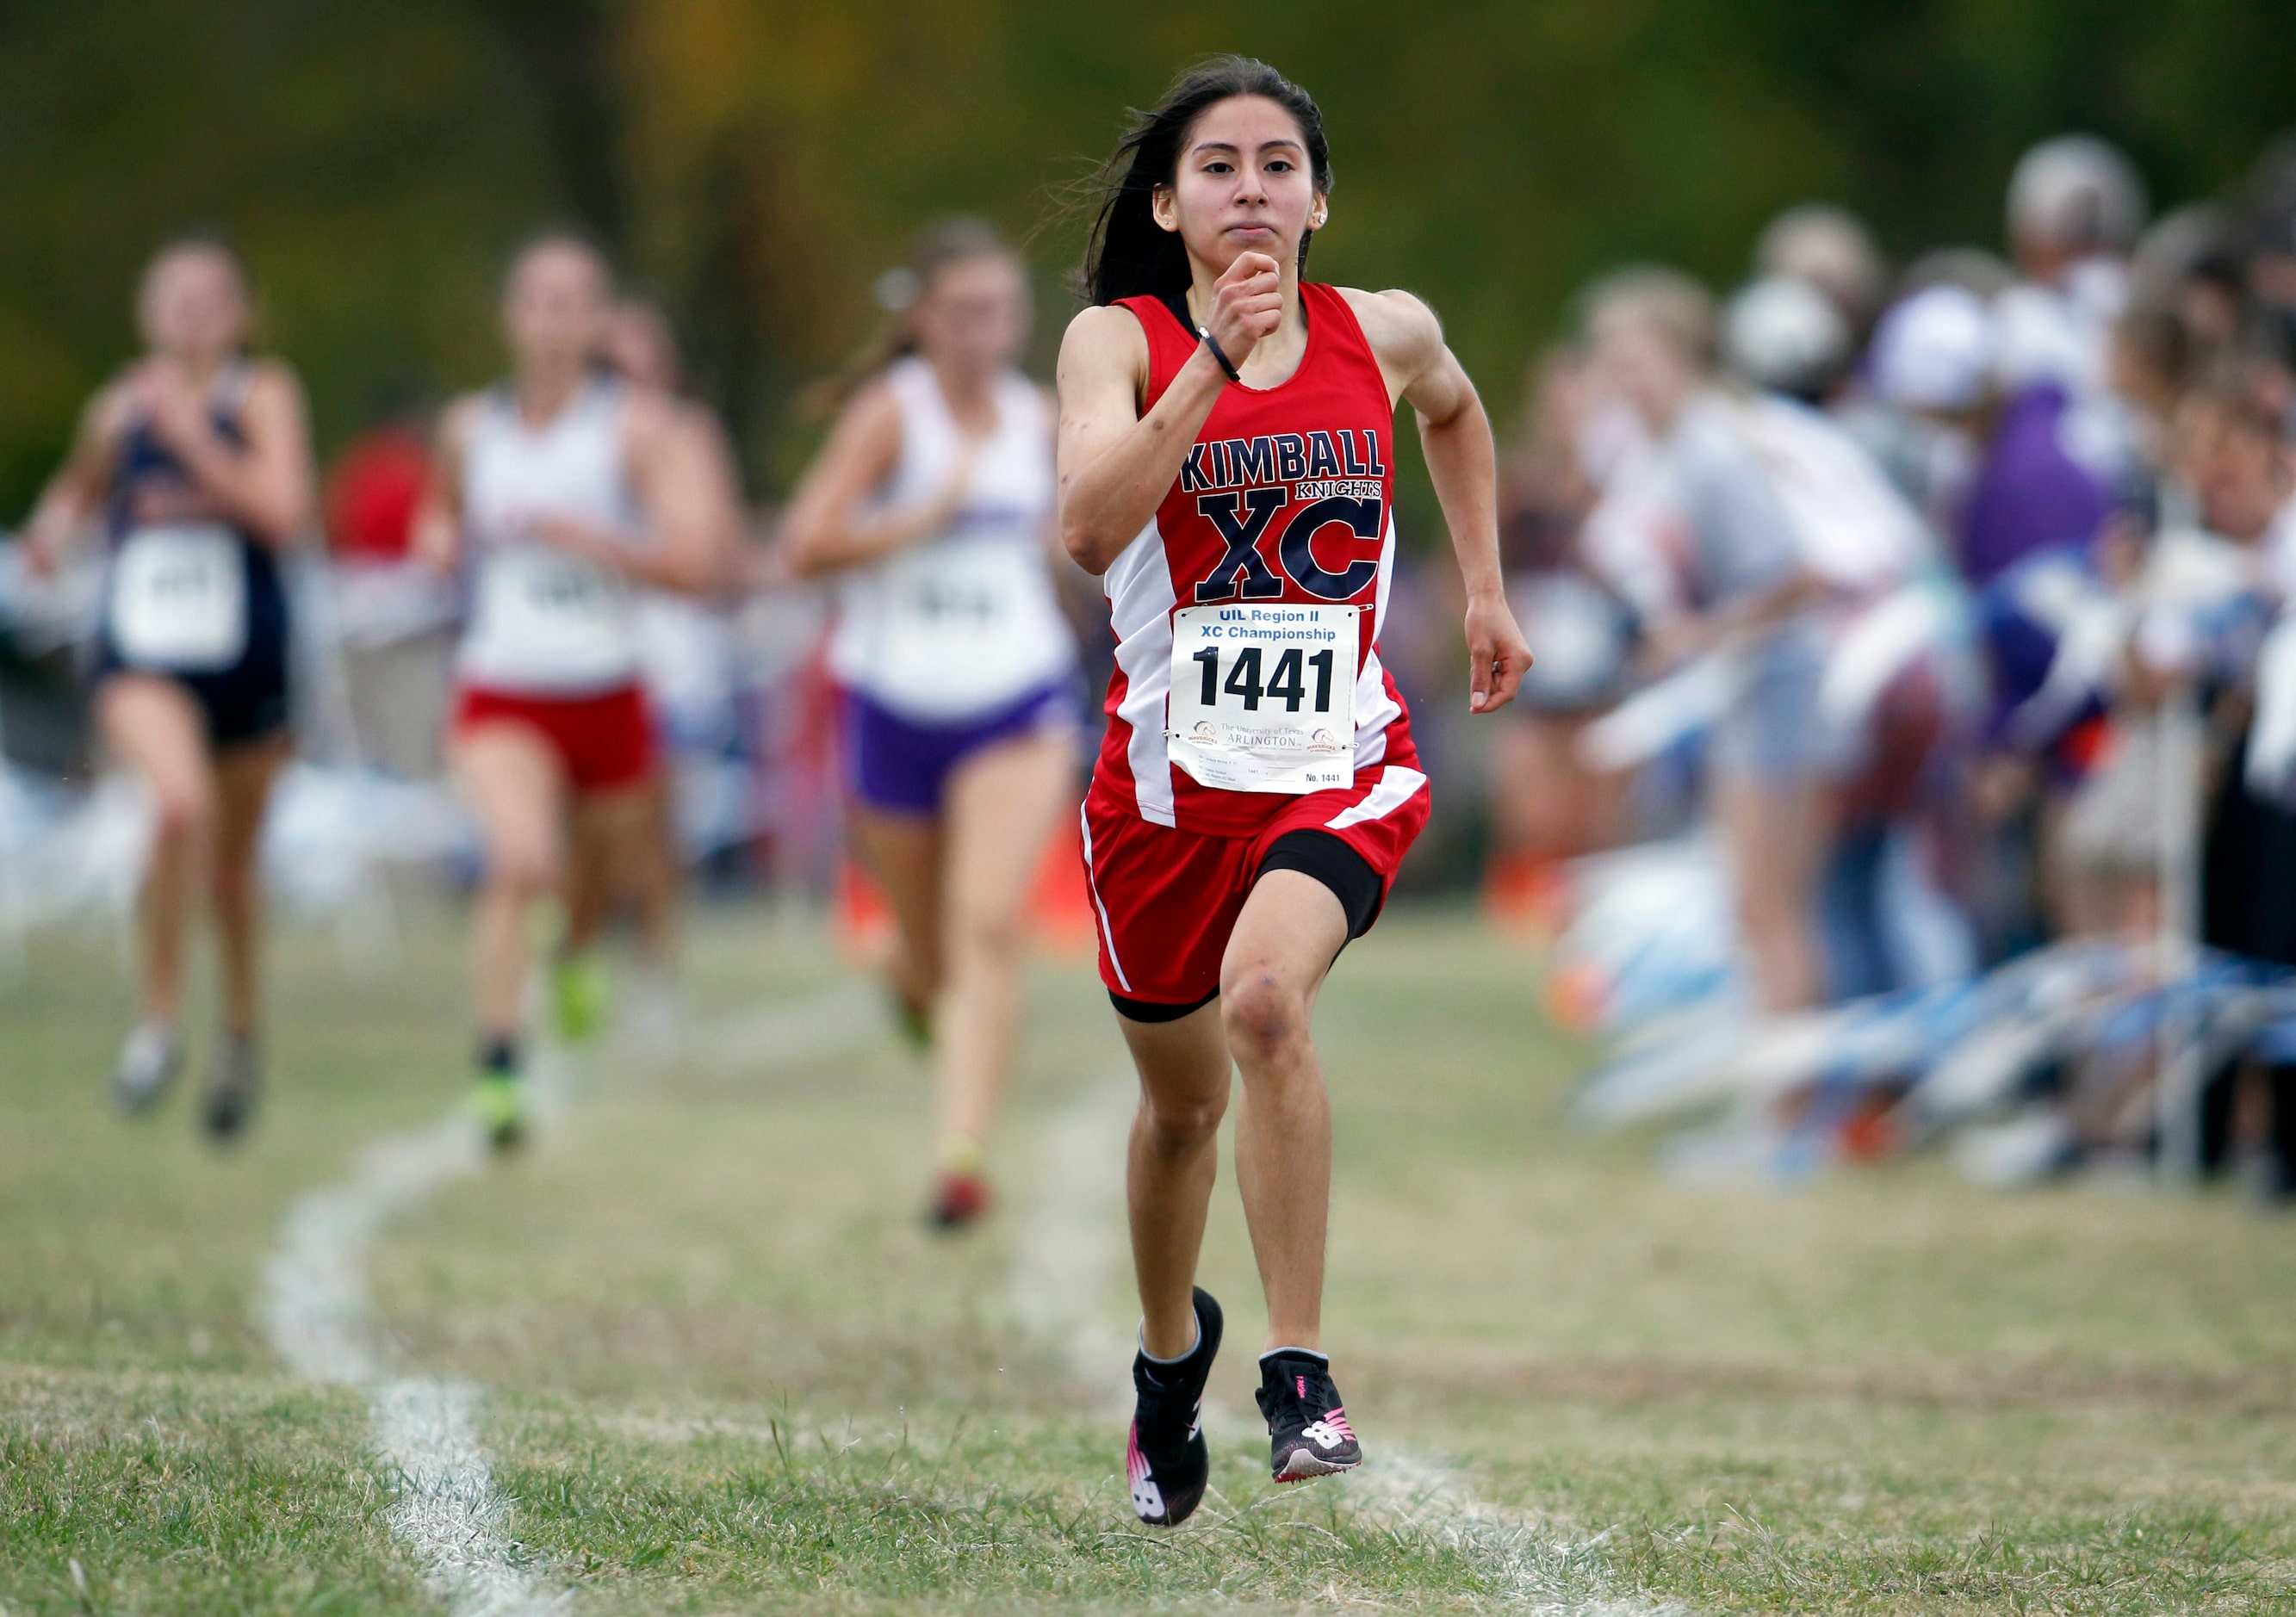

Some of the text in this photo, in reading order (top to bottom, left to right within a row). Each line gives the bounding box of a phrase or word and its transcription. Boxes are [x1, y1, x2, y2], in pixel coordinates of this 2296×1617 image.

[1181, 430, 1384, 493] KIMBALL
[1294, 480, 1382, 500] KNIGHTS
[1195, 487, 1383, 603] XC
[1219, 610, 1319, 623] UIL Region II
[1201, 626, 1336, 642] XC Championship
[1193, 646, 1334, 713] 1441
[1221, 723, 1235, 732] The
[1237, 725, 1271, 735] University
[1283, 727, 1304, 735] Texas
[1226, 734, 1296, 747] ARLINGTON
[1306, 773, 1319, 783] No.
